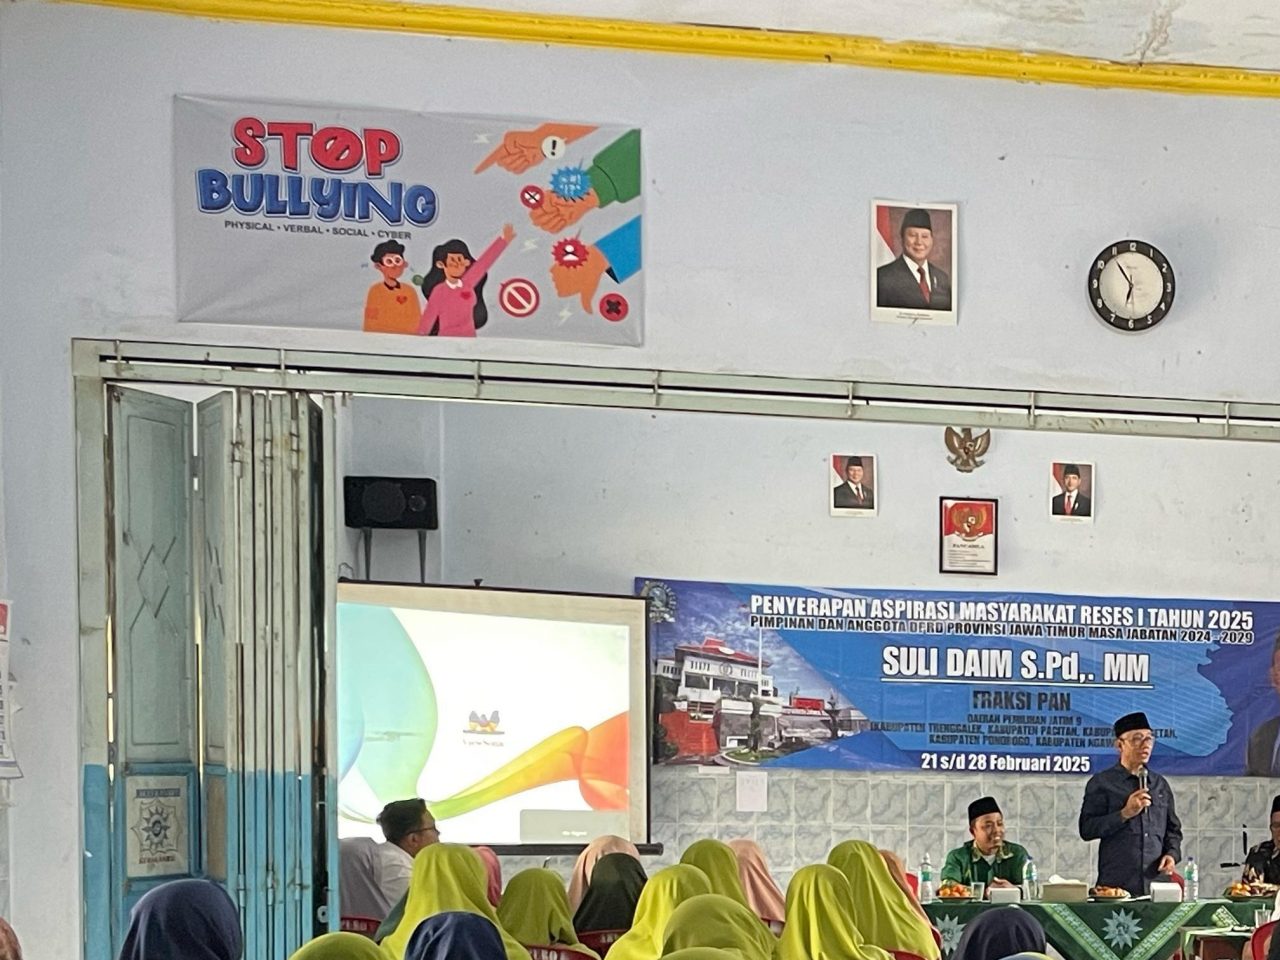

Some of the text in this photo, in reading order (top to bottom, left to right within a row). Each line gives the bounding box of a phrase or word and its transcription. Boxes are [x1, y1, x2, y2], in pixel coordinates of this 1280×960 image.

[232, 117, 402, 177] STOP
[197, 168, 437, 225] BULLYING
[224, 220, 412, 240] PHYSICAL VERBAL SOCIAL CYBER
[751, 594, 1253, 630] PENYERAPAN ASPIRASI MASYARAKAT RESES I TAHUN 2025
[750, 615, 815, 630] PIMPINAN
[818, 617, 845, 631] DAN
[848, 619, 906, 633] ANGGOTA
[948, 622, 1007, 635] PROVINSI
[1009, 624, 1043, 636] JAWA
[1045, 625, 1085, 638] TIMUR
[1088, 627, 1123, 639] MASA
[1126, 628, 1177, 641] JABATAN
[1180, 630, 1211, 643] 2024
[1221, 631, 1254, 644] 2029
[882, 646, 938, 676] SULI
[946, 648, 1013, 679] DAIM
[1103, 652, 1149, 682] MM
[973, 690, 1071, 711] FRAKSI PAN
[921, 753, 1091, 772] 21 s/d 28 Februari 2025
